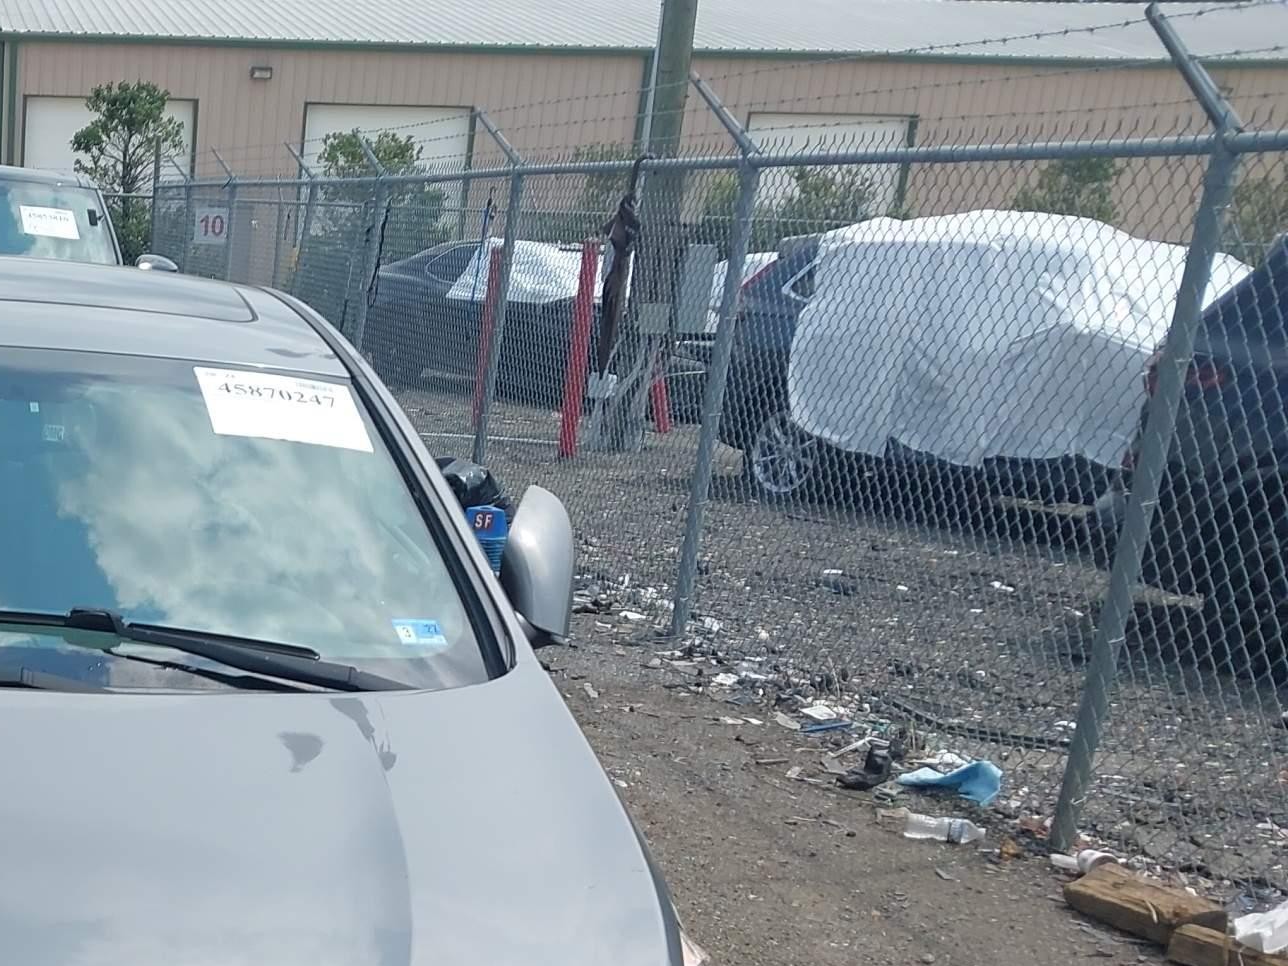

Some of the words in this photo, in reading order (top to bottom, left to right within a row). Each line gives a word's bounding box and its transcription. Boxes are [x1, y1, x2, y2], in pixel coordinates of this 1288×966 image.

[199, 214, 225, 237] 10
[217, 382, 335, 408] 45870247
[474, 512, 493, 529] SF
